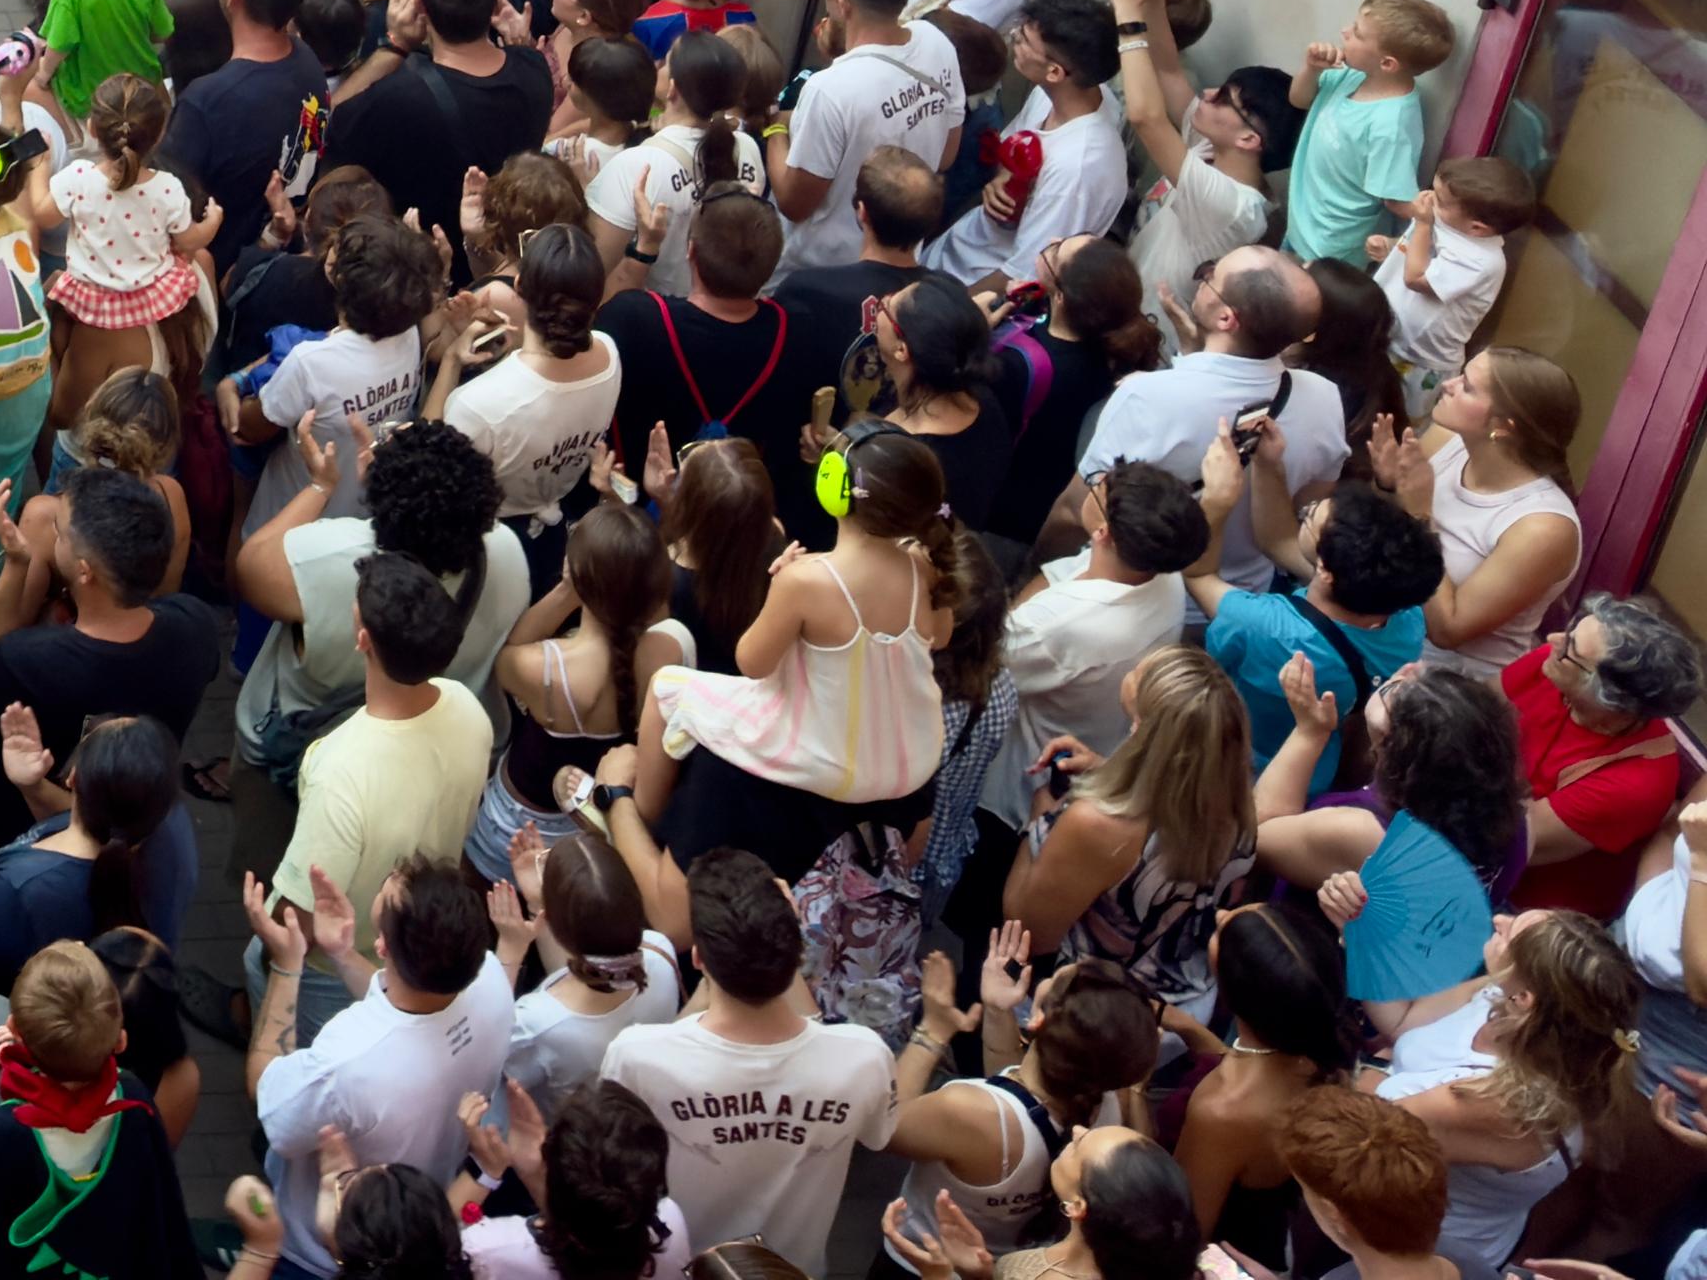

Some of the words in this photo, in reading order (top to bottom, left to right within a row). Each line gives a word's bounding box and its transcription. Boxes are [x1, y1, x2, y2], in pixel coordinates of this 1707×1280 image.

[343, 378, 397, 415] GLÒRIA
[368, 395, 411, 426] SANTES
[671, 1090, 767, 1121] GLÒRIA
[777, 1093, 793, 1116] A
[802, 1099, 851, 1125] LES
[713, 1120, 807, 1146] SANTES
